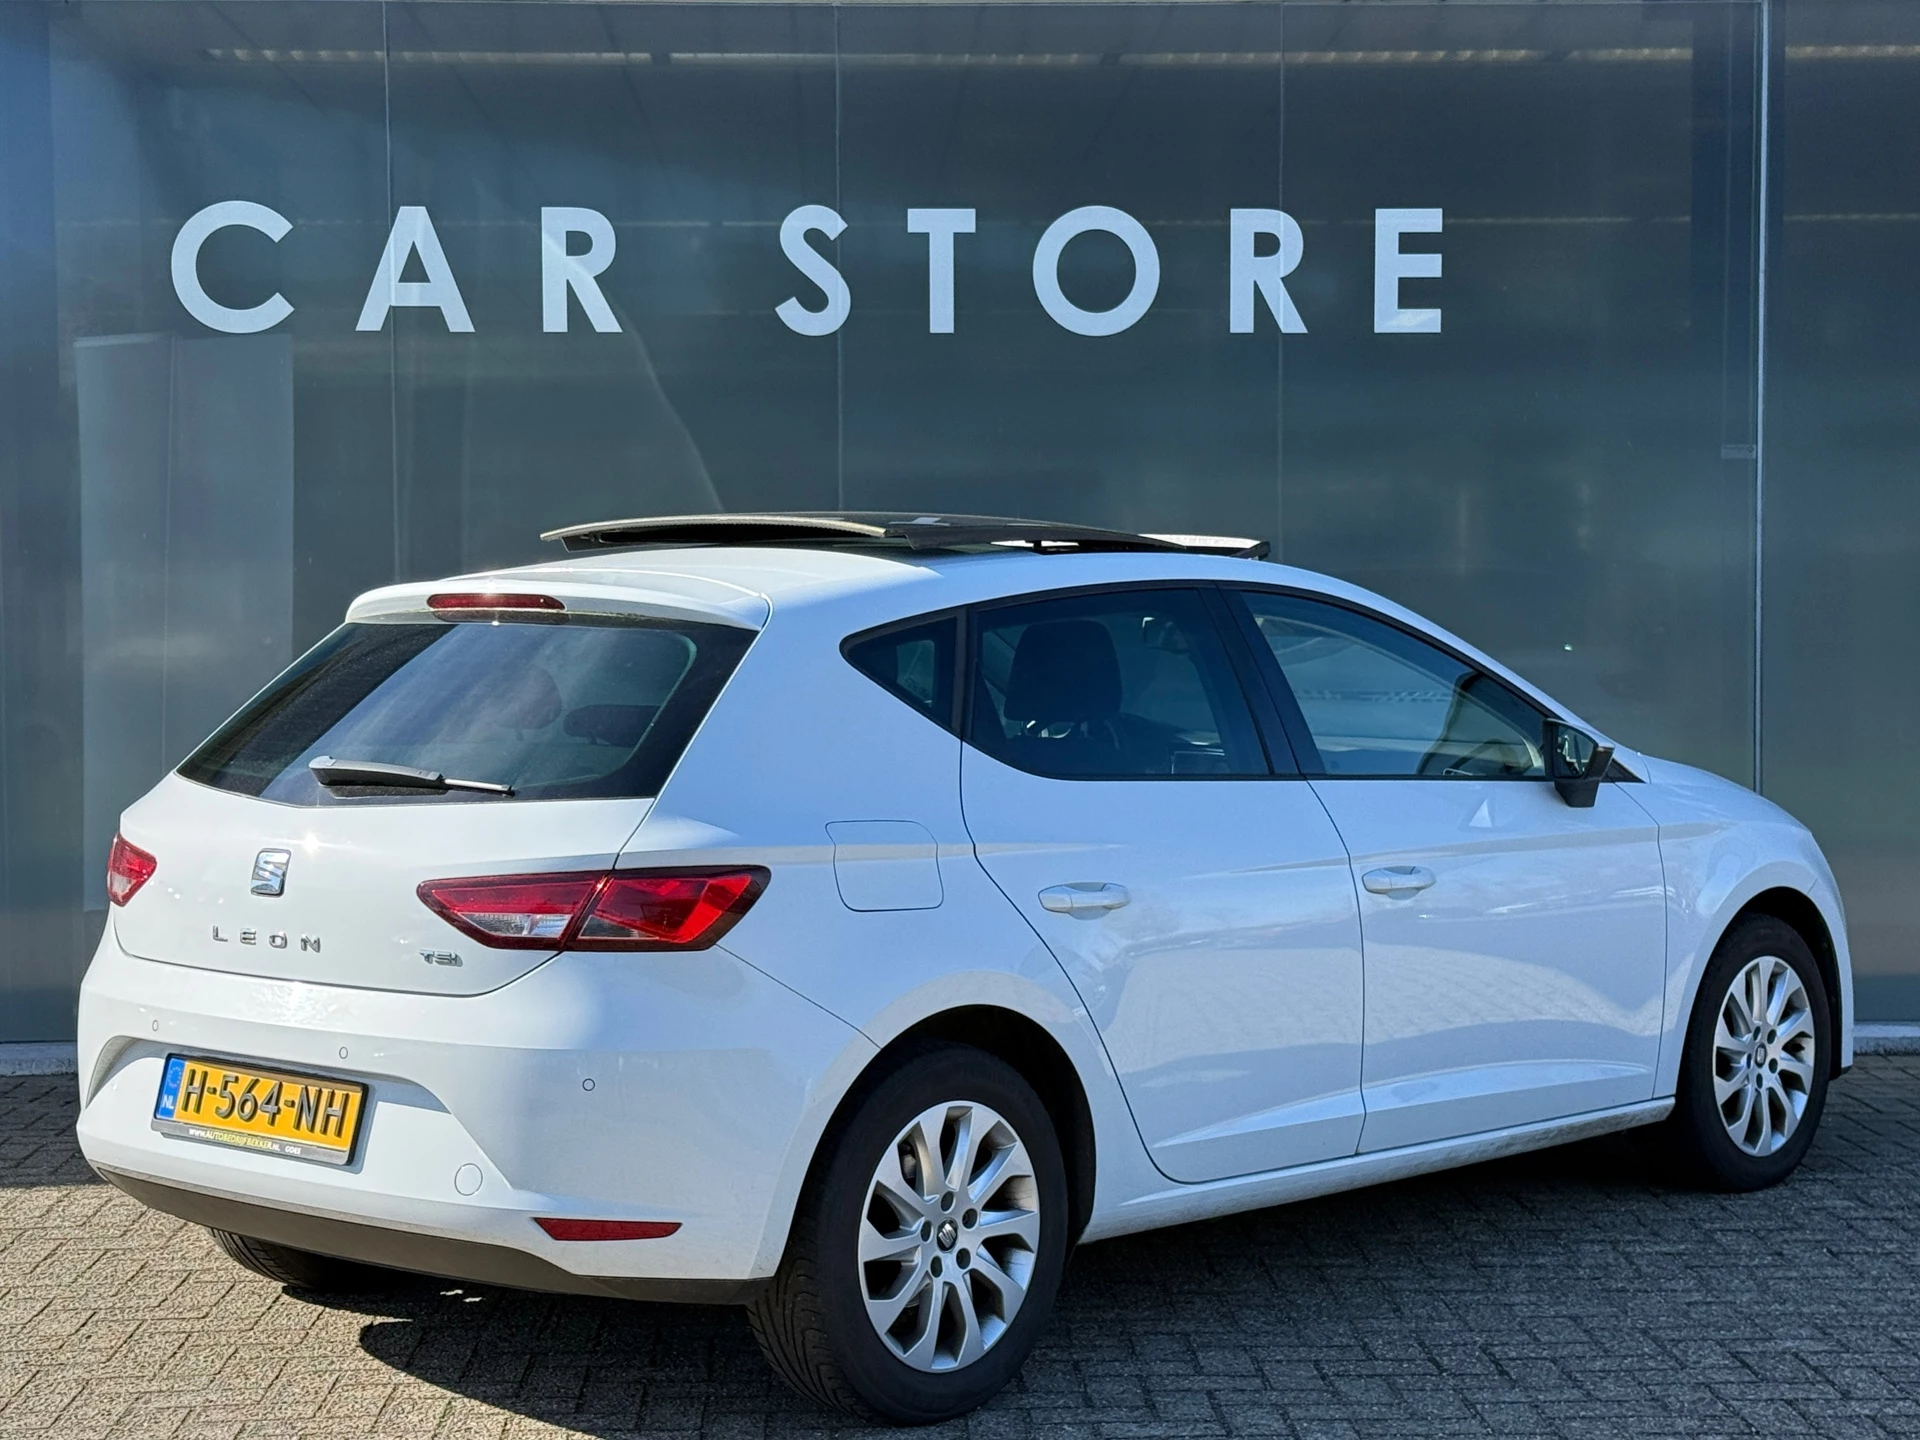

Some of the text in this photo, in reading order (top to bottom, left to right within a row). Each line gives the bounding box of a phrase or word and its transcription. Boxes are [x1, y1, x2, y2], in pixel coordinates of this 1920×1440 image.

[171, 201, 1443, 337] CAR STORE
[212, 924, 321, 953] LEON
[161, 1094, 175, 1110] NL
[181, 1068, 349, 1138] H-564-NH
